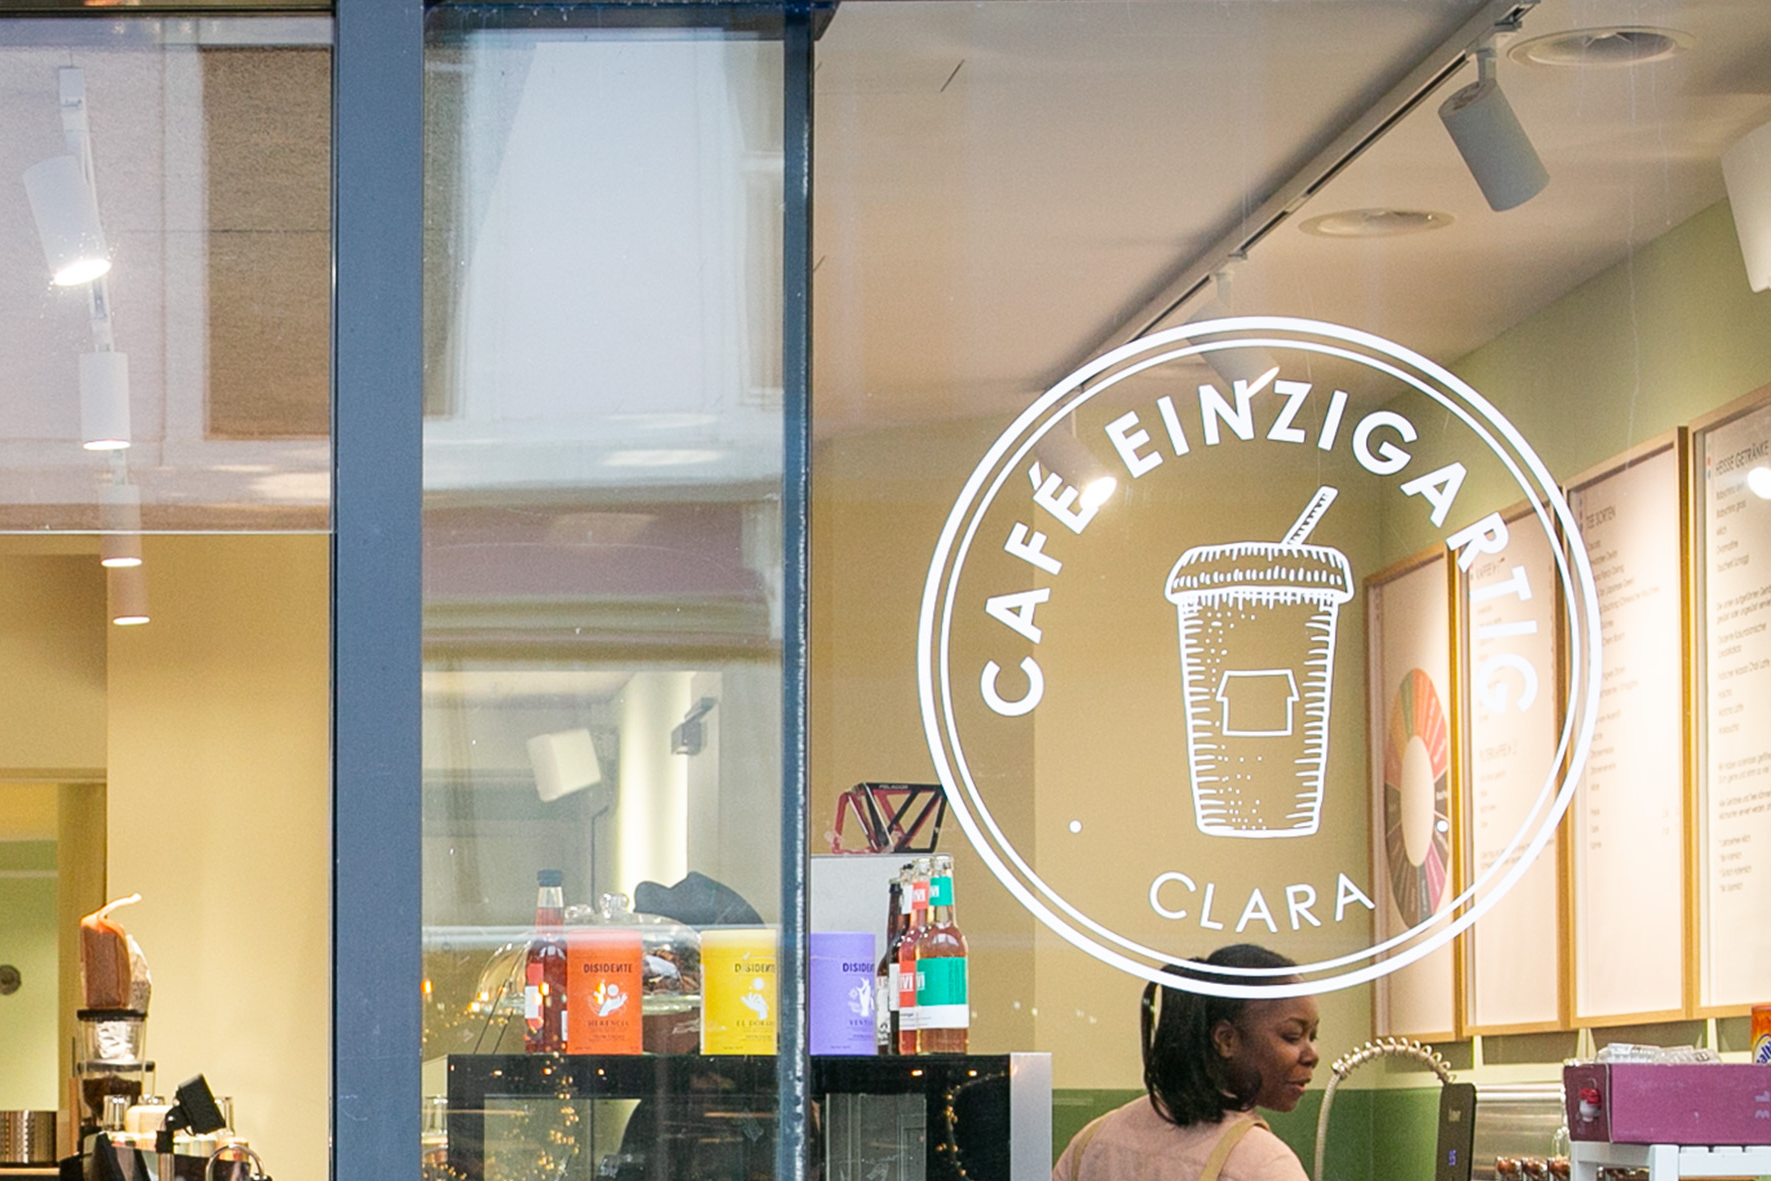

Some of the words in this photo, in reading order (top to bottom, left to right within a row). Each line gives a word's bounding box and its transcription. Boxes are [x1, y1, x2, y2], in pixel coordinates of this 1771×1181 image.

[981, 463, 1100, 717] CAFÉ
[1105, 379, 1538, 717] EINZIGARTIG
[1149, 872, 1375, 933] CLARA
